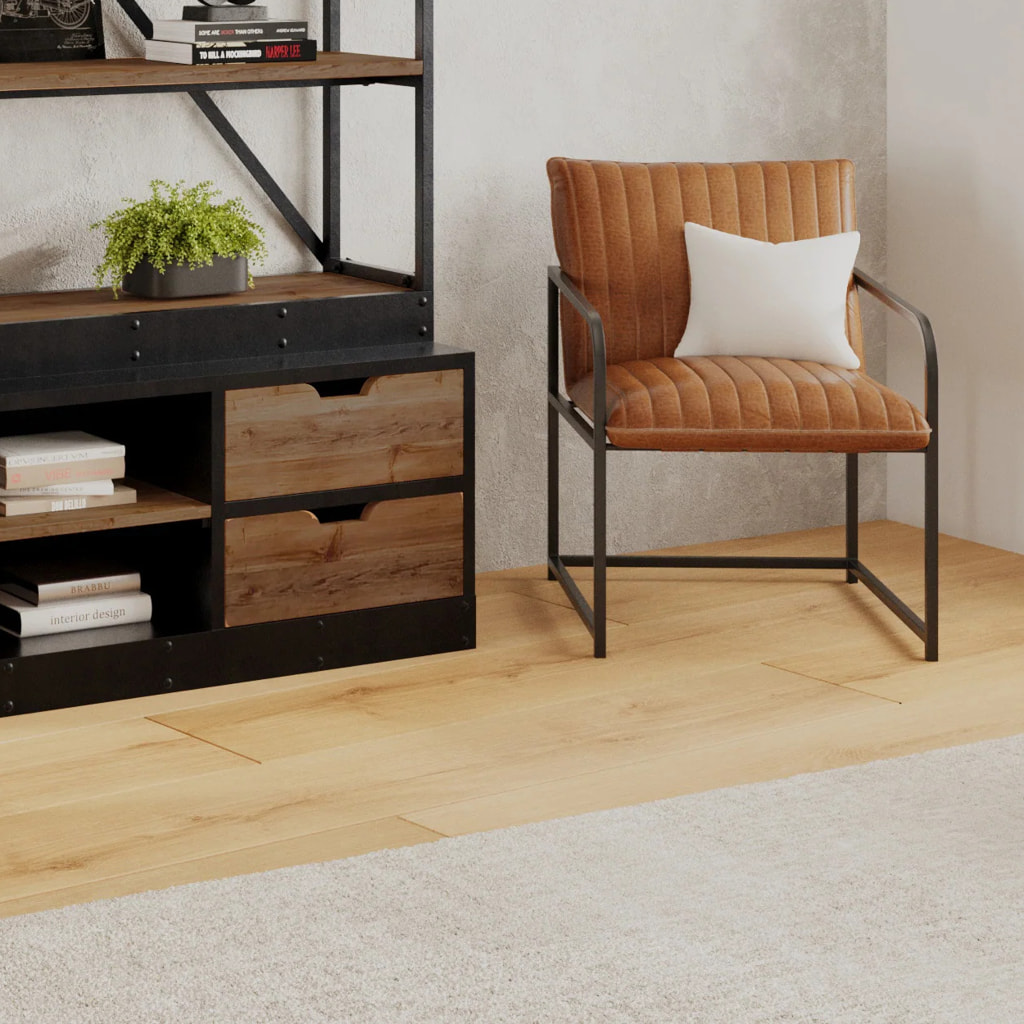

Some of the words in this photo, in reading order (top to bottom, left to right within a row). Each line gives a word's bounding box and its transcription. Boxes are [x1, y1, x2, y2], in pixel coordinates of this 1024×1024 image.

[199, 51, 208, 60] TO
[220, 50, 225, 59] A
[265, 45, 289, 59] HARPER
[289, 44, 301, 58] LEE
[71, 582, 111, 594] BRABBU
[49, 610, 91, 626] interior
[92, 607, 126, 621] design
